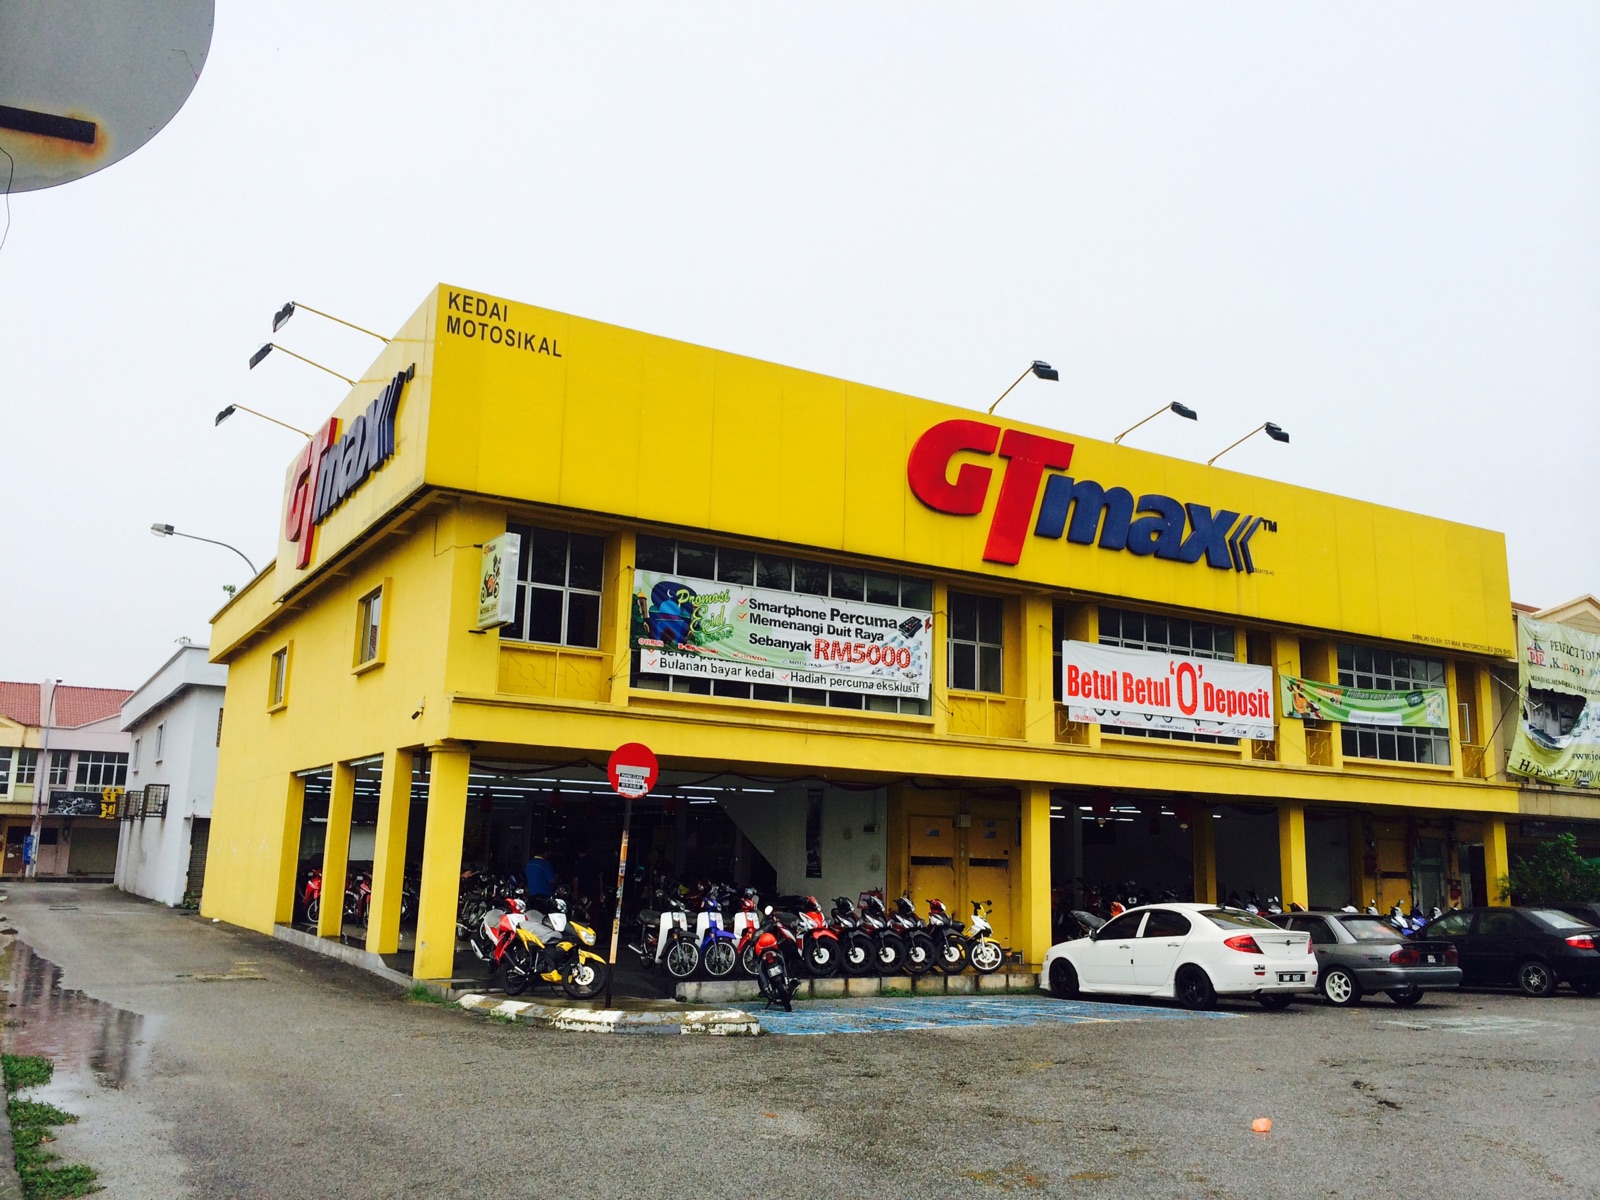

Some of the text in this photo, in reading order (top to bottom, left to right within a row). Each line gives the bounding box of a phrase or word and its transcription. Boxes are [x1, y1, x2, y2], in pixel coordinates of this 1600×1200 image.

[448, 291, 508, 322] KEDAI
[446, 315, 562, 358] MOTOSIKAL
[907, 419, 1239, 569] GTmax
[676, 588, 731, 608] Promosi
[690, 605, 735, 635] Eid
[749, 598, 898, 630] Smartphone Percuma
[749, 613, 884, 643] Memenangi Duit Raya
[748, 633, 812, 652] Sebanyak
[814, 638, 911, 669] RM5000
[659, 658, 775, 680] Bulanan bayar kedai
[790, 671, 920, 694] Hadiah percuma eksklusif
[1067, 664, 1118, 702] Betul
[1122, 671, 1171, 707] Betul
[1203, 681, 1270, 719] Deposit
